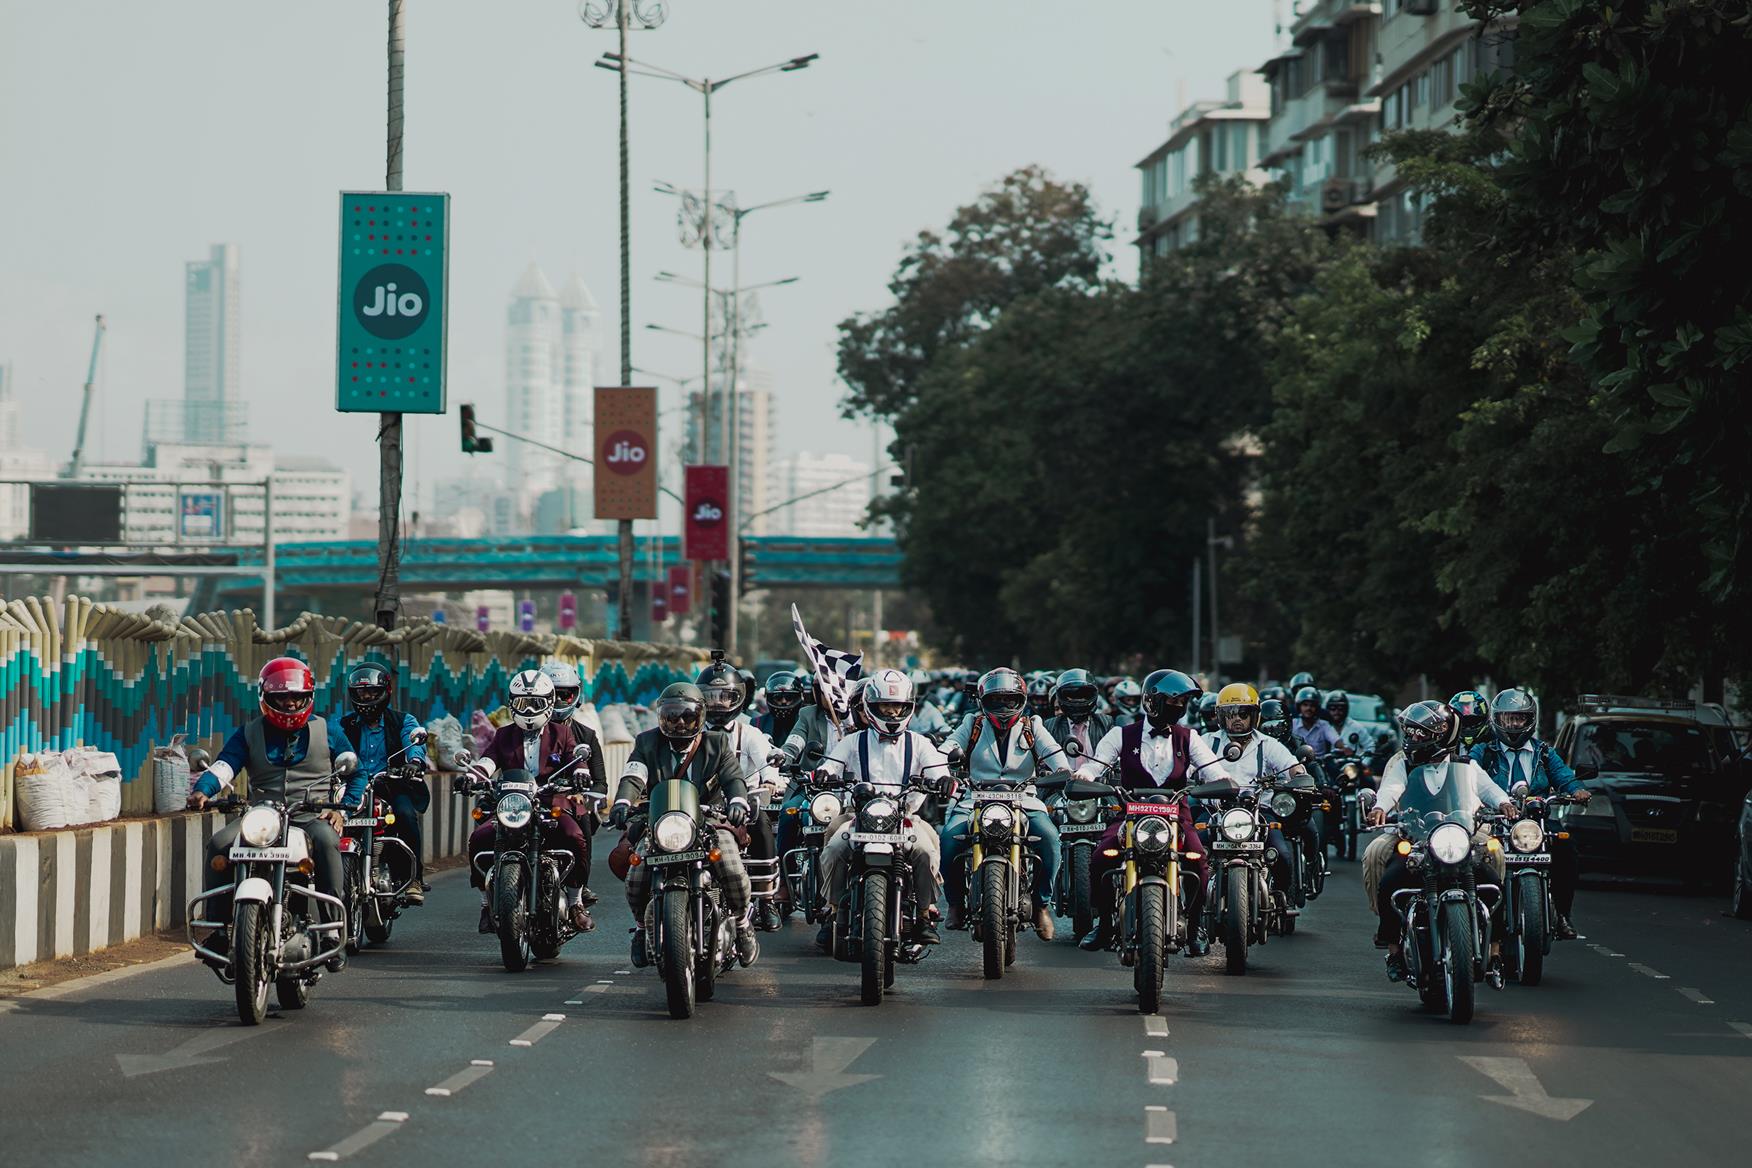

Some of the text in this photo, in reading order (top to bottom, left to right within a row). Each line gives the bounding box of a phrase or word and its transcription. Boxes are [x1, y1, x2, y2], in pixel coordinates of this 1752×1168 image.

[362, 282, 423, 317] Jio
[608, 441, 646, 462] Jio
[694, 503, 722, 521] Jio
